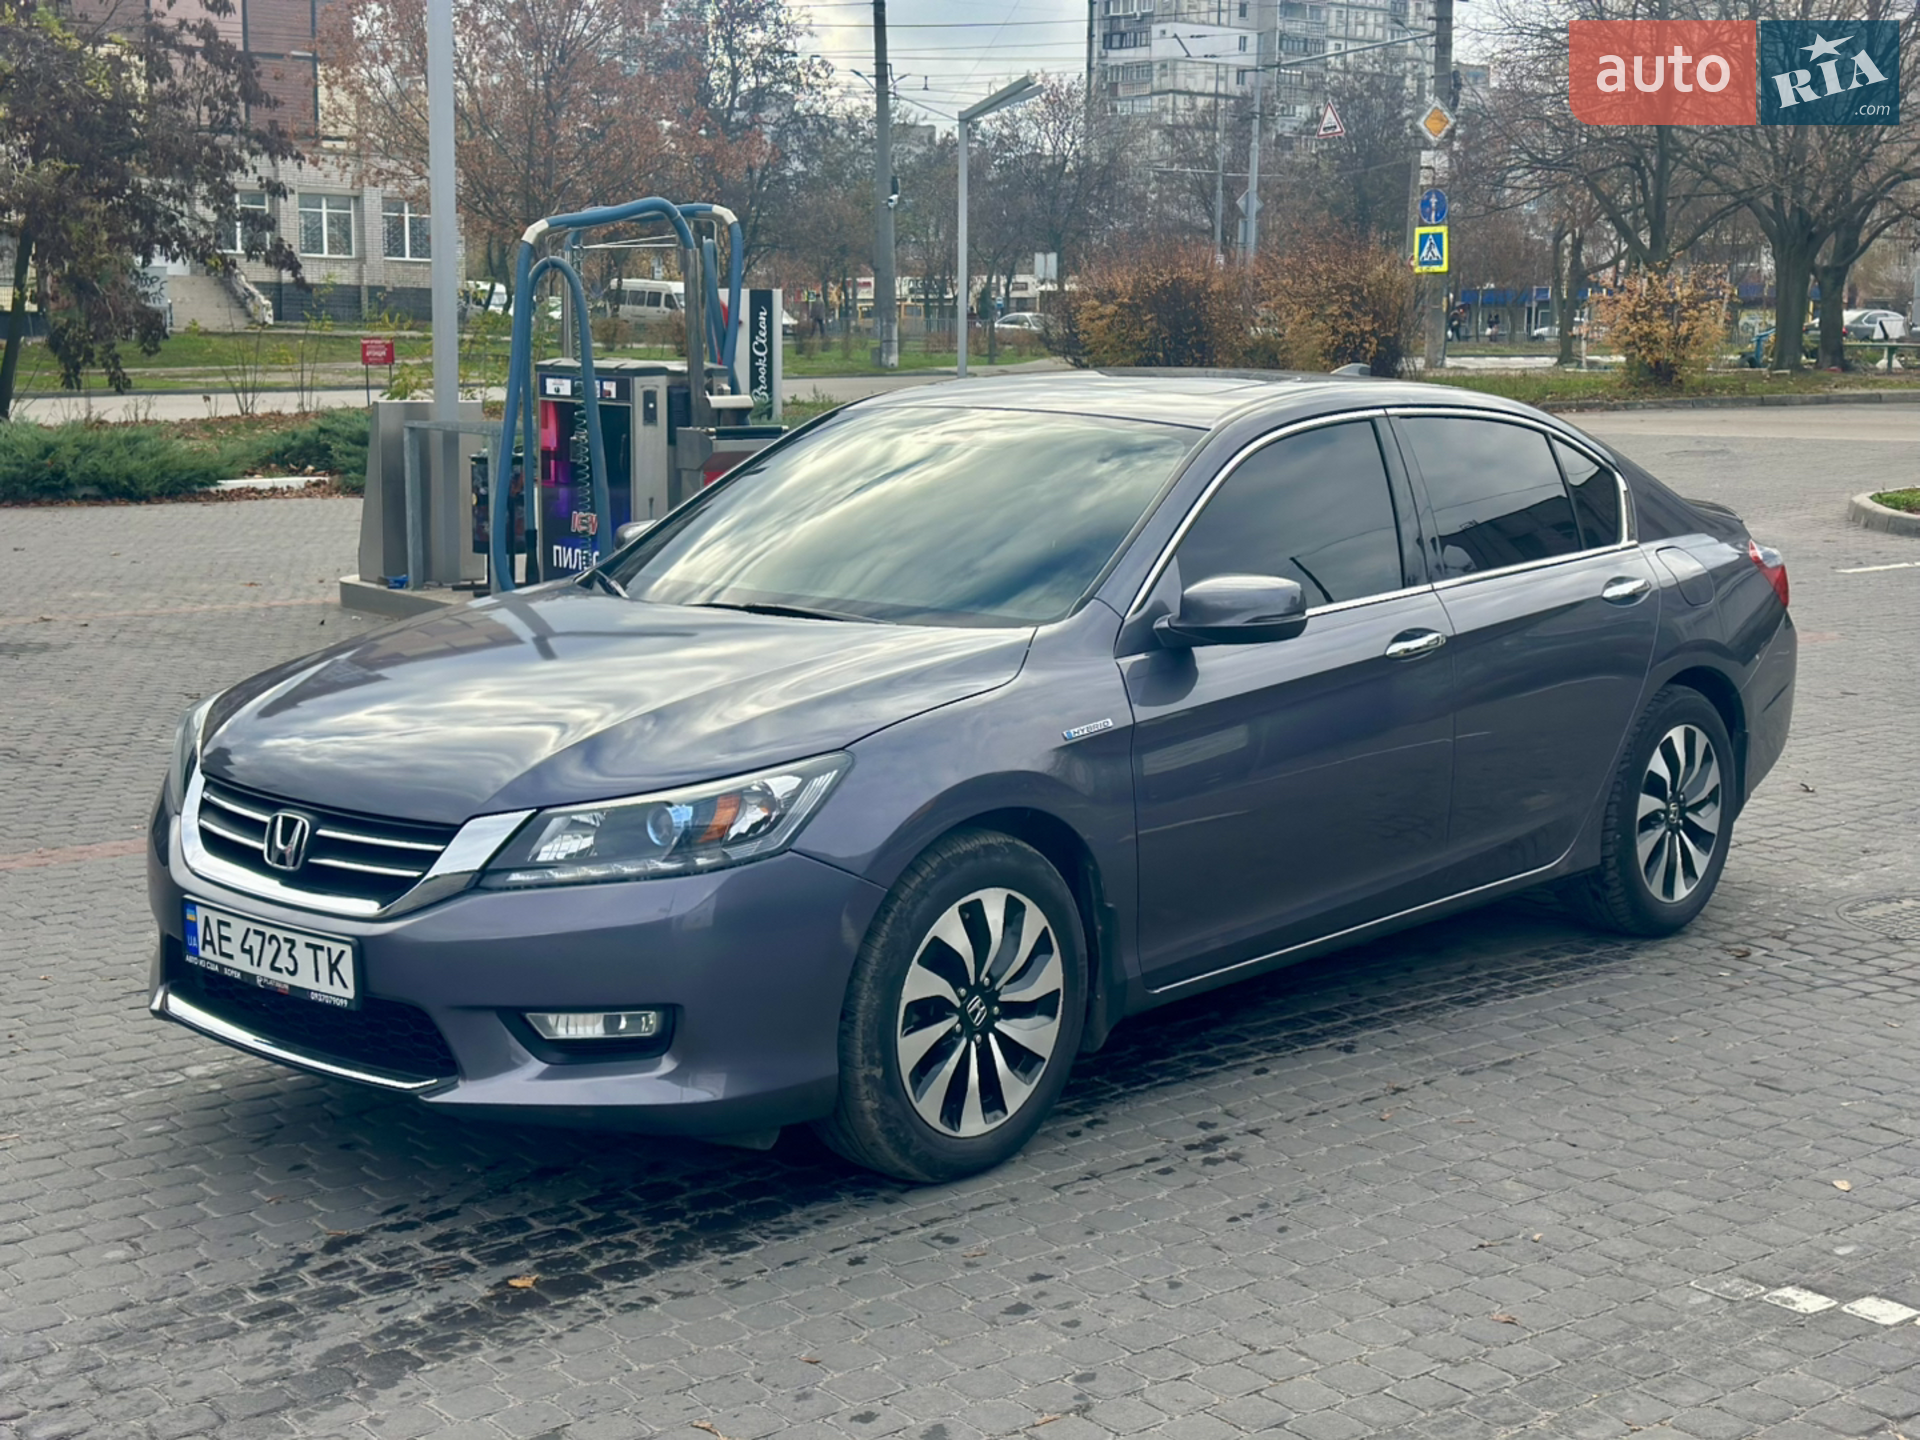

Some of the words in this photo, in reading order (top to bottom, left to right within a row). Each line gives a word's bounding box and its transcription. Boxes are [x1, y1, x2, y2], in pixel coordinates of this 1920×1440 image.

[1072, 720, 1110, 737] HYBRID
[187, 936, 198, 948] UA
[201, 915, 235, 960] AE
[240, 926, 299, 977] 4723
[304, 942, 348, 989] TK
